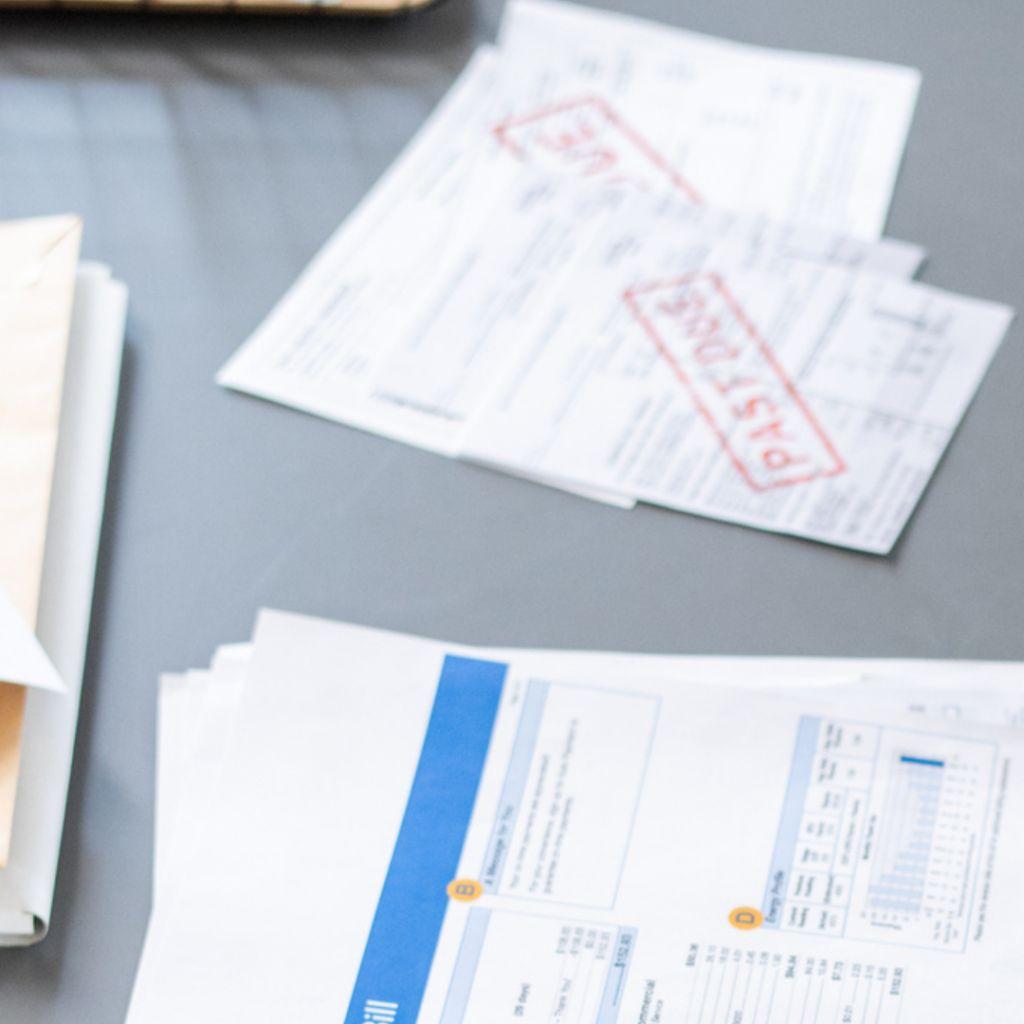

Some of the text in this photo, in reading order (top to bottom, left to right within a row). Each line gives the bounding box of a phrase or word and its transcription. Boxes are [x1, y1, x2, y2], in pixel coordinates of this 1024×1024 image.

[535, 122, 648, 188] UE
[657, 288, 808, 472] PAST DUE
[486, 837, 505, 876] Message
[454, 883, 475, 896] B
[764, 869, 784, 923] Energy Profile
[734, 911, 755, 924] D
[553, 994, 567, 1016] Thank
[650, 999, 663, 1023] Service
